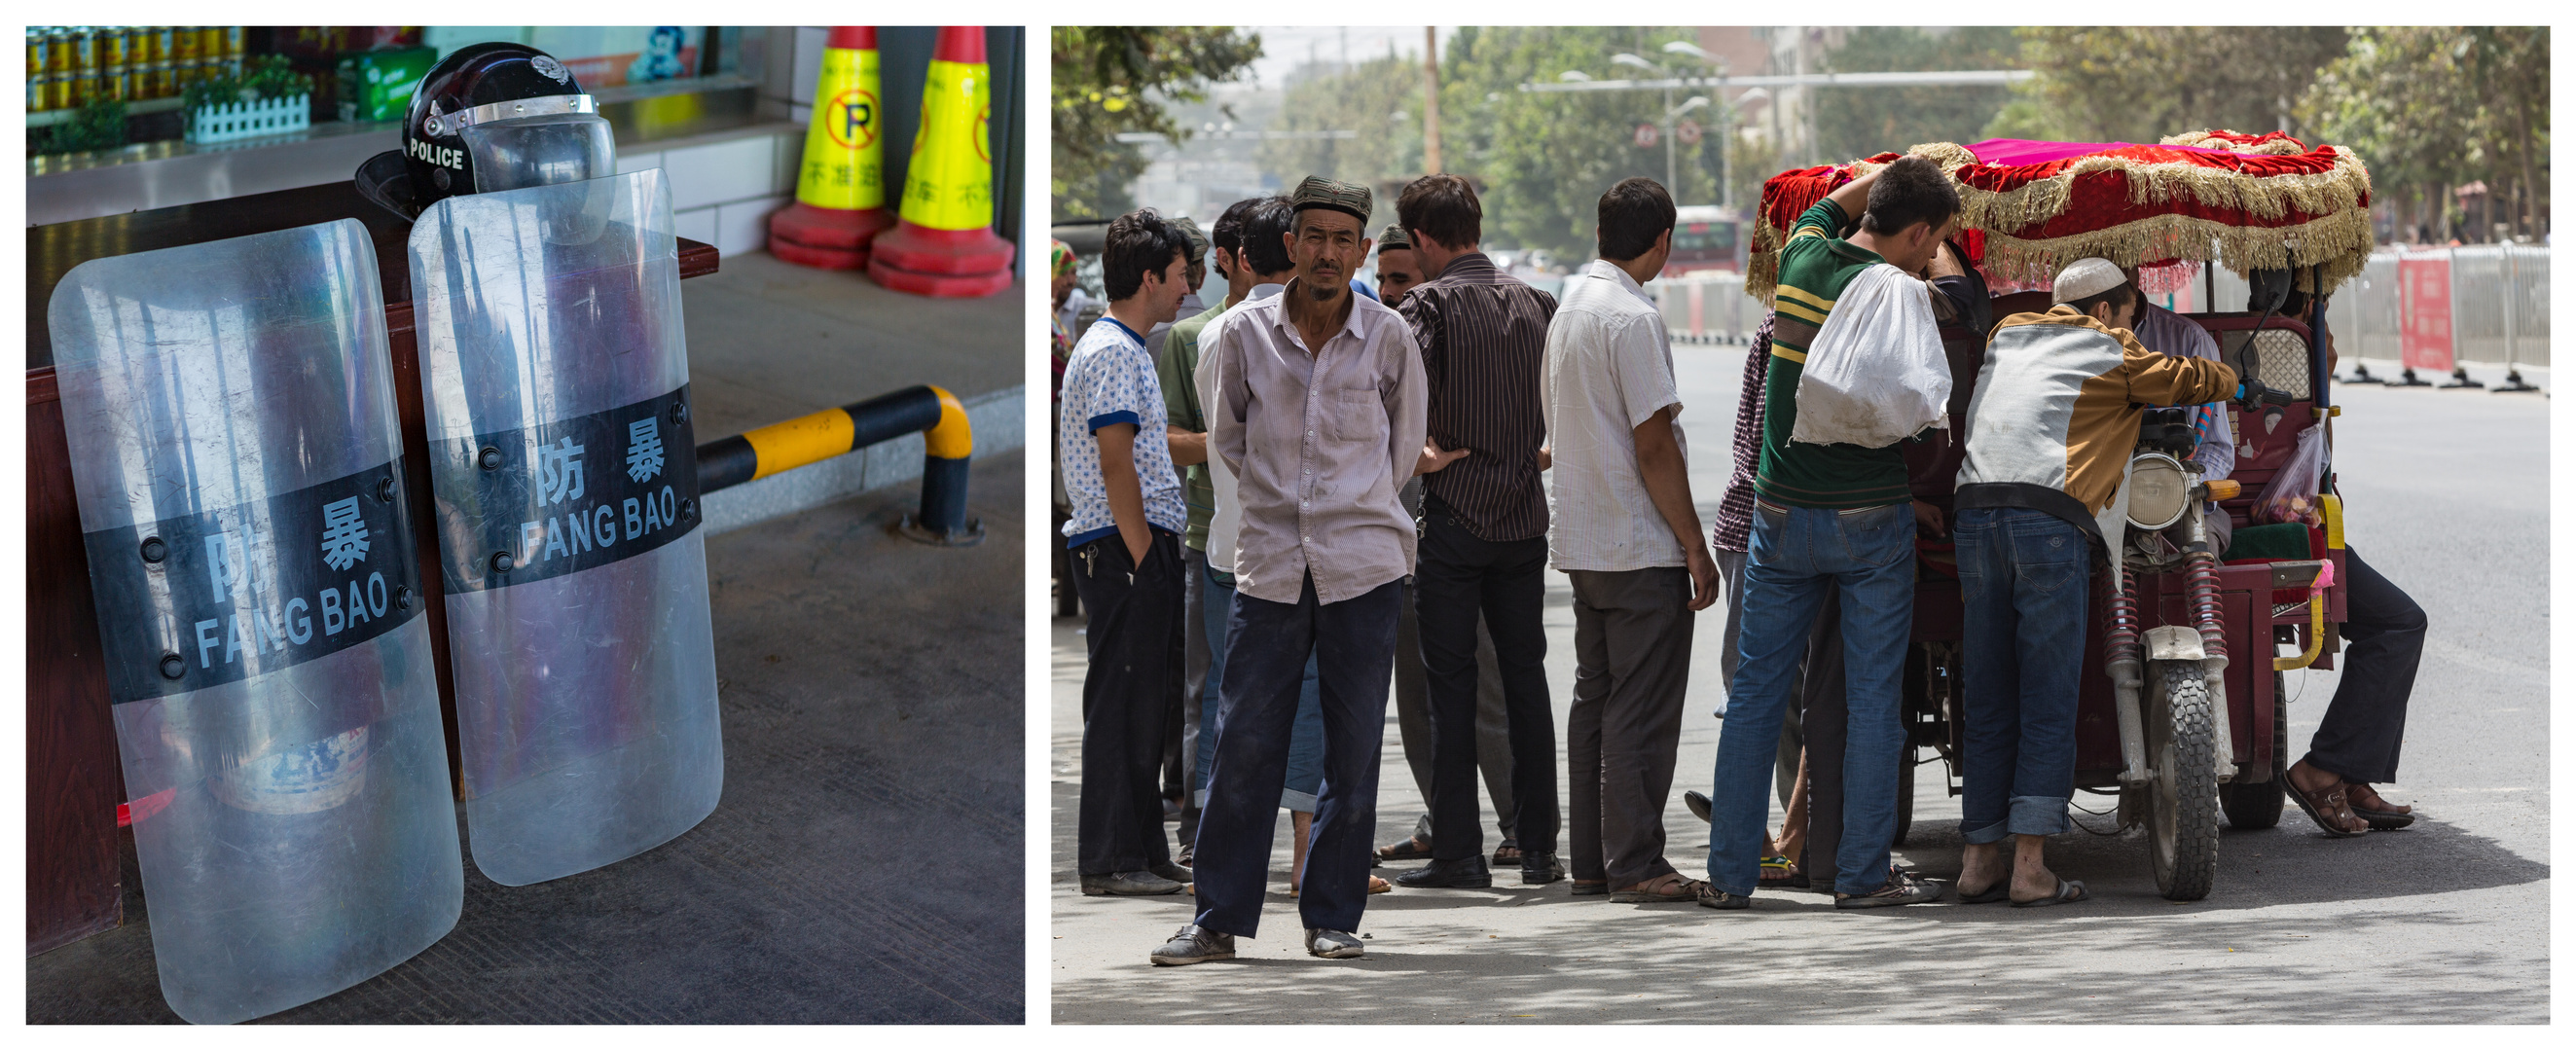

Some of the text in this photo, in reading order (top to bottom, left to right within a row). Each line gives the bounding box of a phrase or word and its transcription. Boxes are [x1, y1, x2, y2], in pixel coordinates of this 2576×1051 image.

[411, 137, 463, 170] POLICE
[531, 416, 665, 508] 防暴
[203, 495, 371, 604] 防暴
[521, 485, 675, 565] FANG BAO
[195, 571, 388, 670] FANG BAO
